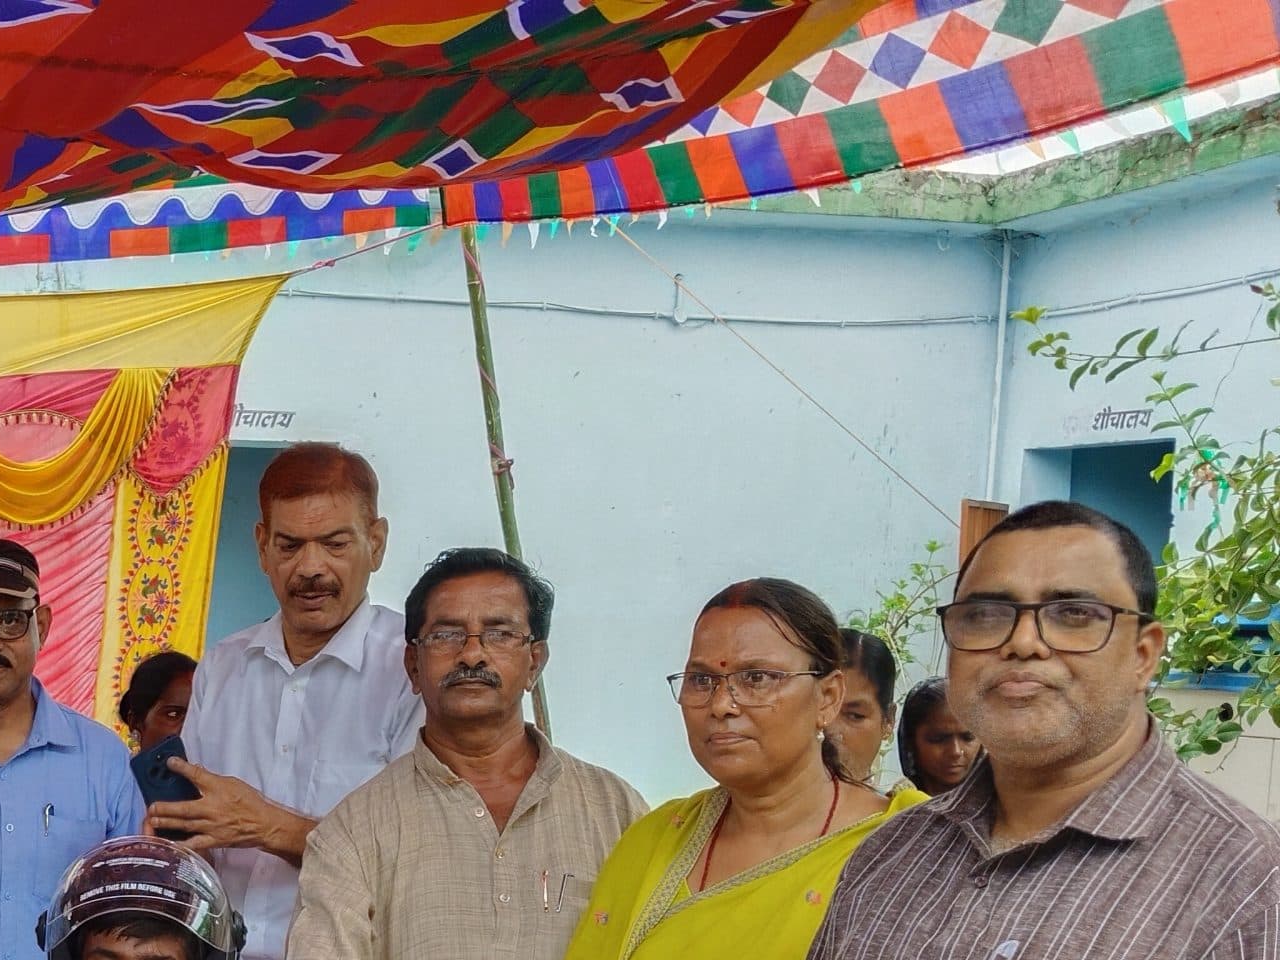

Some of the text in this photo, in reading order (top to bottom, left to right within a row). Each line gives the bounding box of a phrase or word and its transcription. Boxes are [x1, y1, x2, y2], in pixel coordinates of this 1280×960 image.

[233, 402, 297, 429] ौचालय
[1092, 406, 1154, 431] शौचालय
[80, 882, 177, 901] REMOVE THIS FILM BEFORE USE
